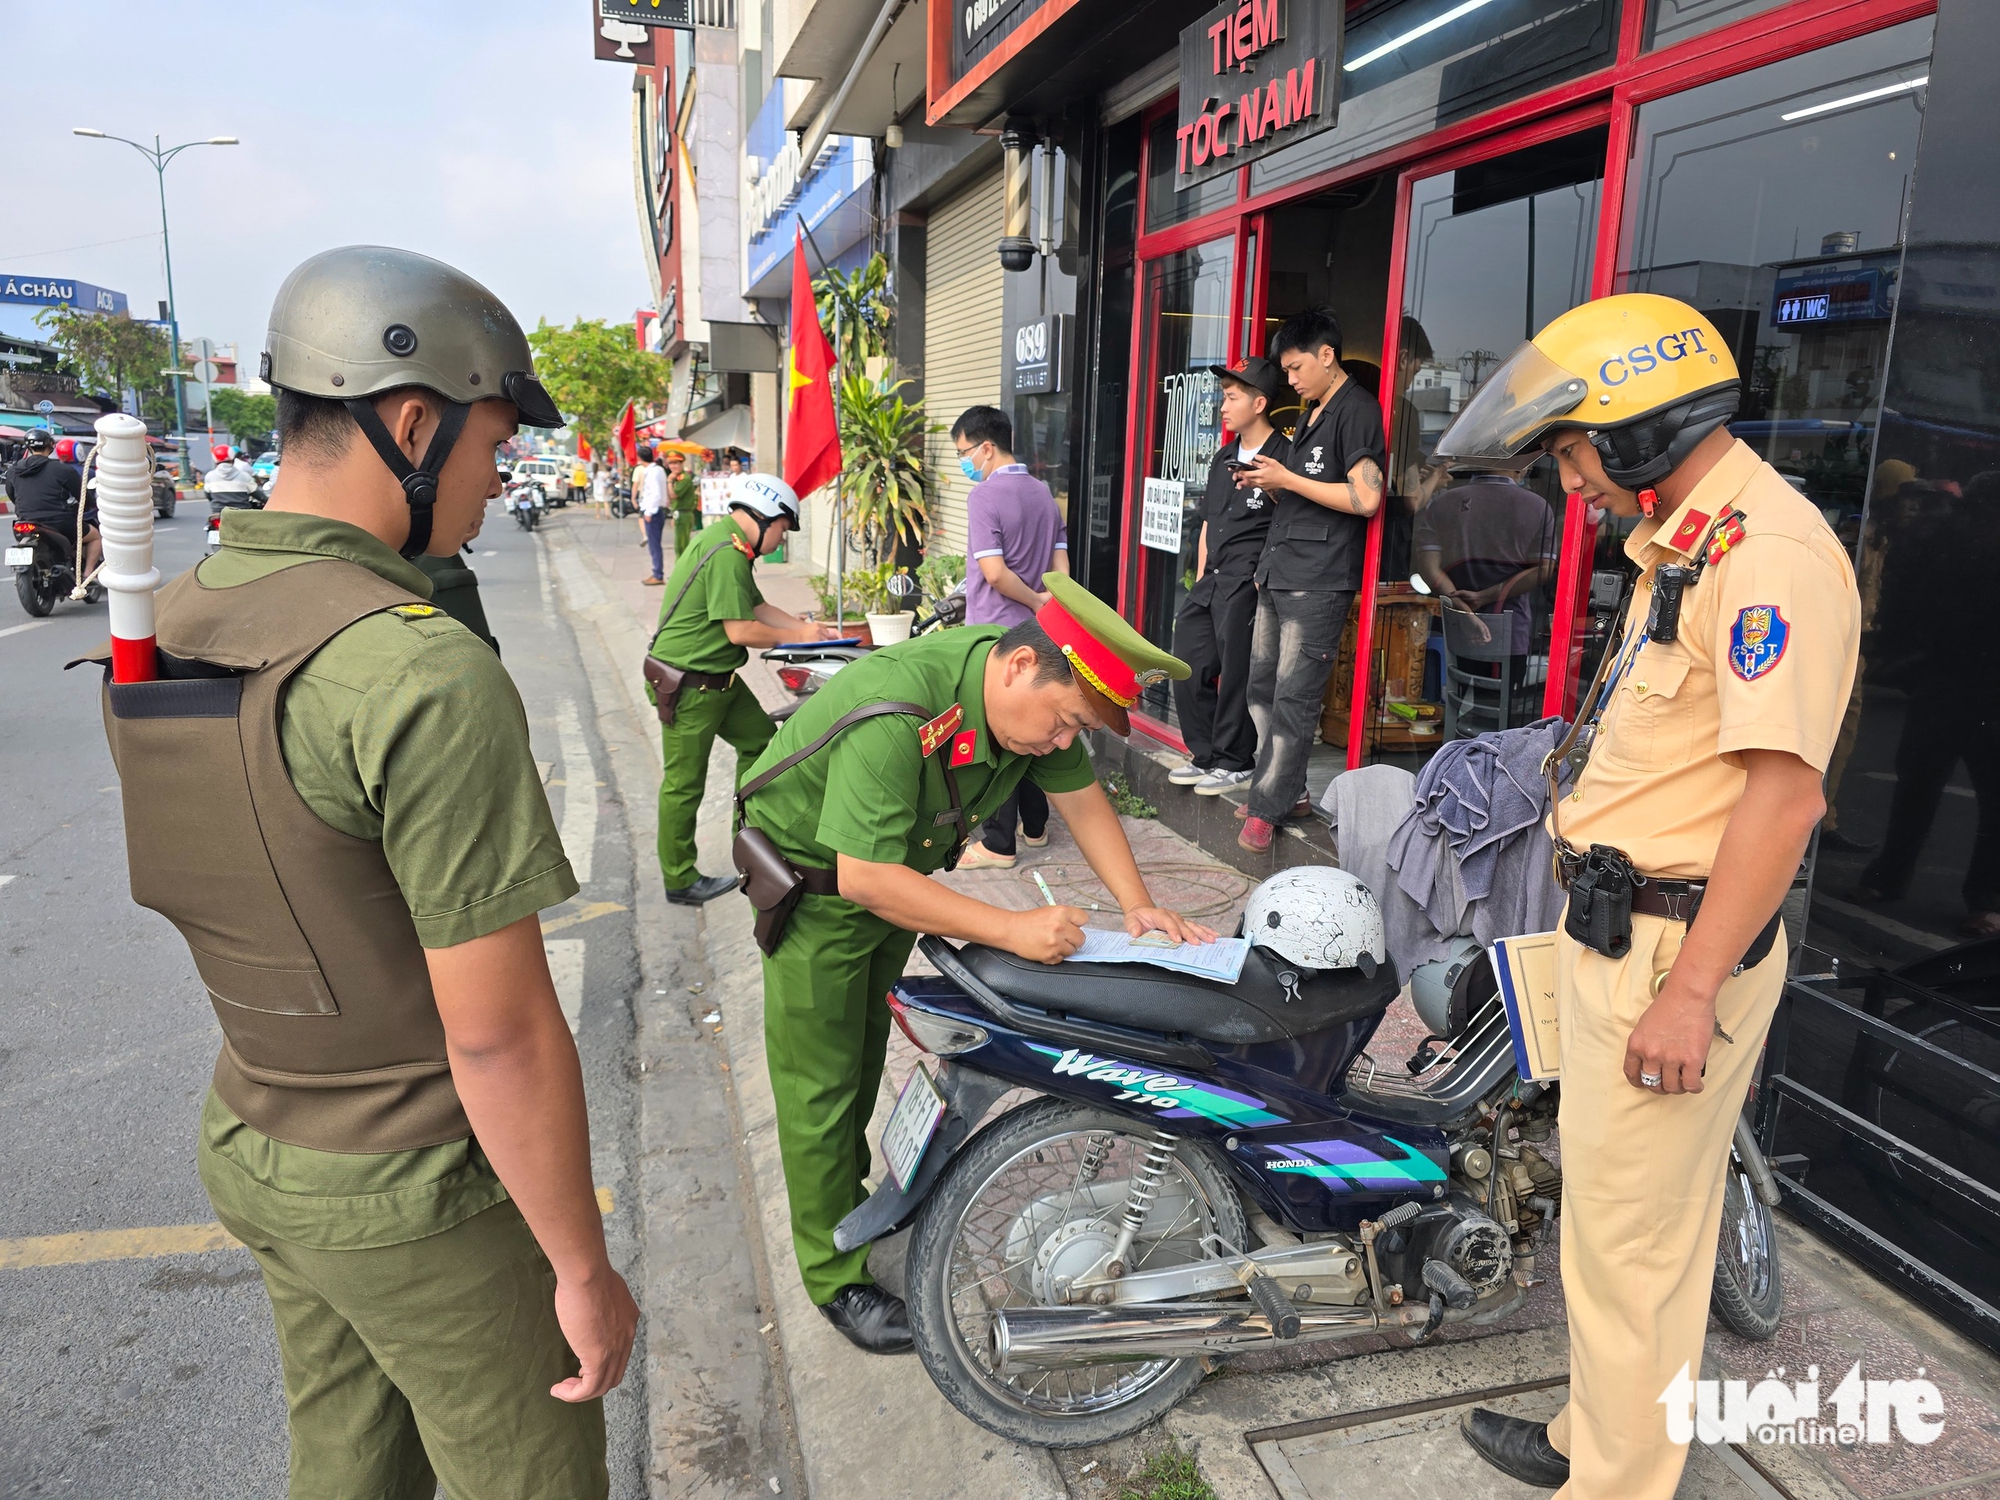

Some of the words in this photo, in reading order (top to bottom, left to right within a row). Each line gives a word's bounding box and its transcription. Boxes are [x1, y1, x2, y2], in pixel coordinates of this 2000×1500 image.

[1208, 0, 1279, 75] TIỆM
[1176, 97, 1231, 174] TÓC
[1238, 58, 1316, 148] NAM
[5, 279, 18, 296] Á
[20, 282, 73, 299] CHÂU
[96, 290, 114, 311] ACB
[1806, 297, 1826, 318] WC
[1016, 322, 1047, 363] 689
[1599, 328, 1708, 386] CSGT
[1161, 373, 1201, 482] 70K
[745, 480, 782, 502] CSTT
[1732, 643, 1778, 656] CSGT
[1541, 1018, 1553, 1026] Quy
[1052, 1048, 1197, 1092] Wave
[905, 1073, 937, 1135] 78-F1
[1113, 1089, 1180, 1108] 110
[1264, 1159, 1314, 1170] HONDA
